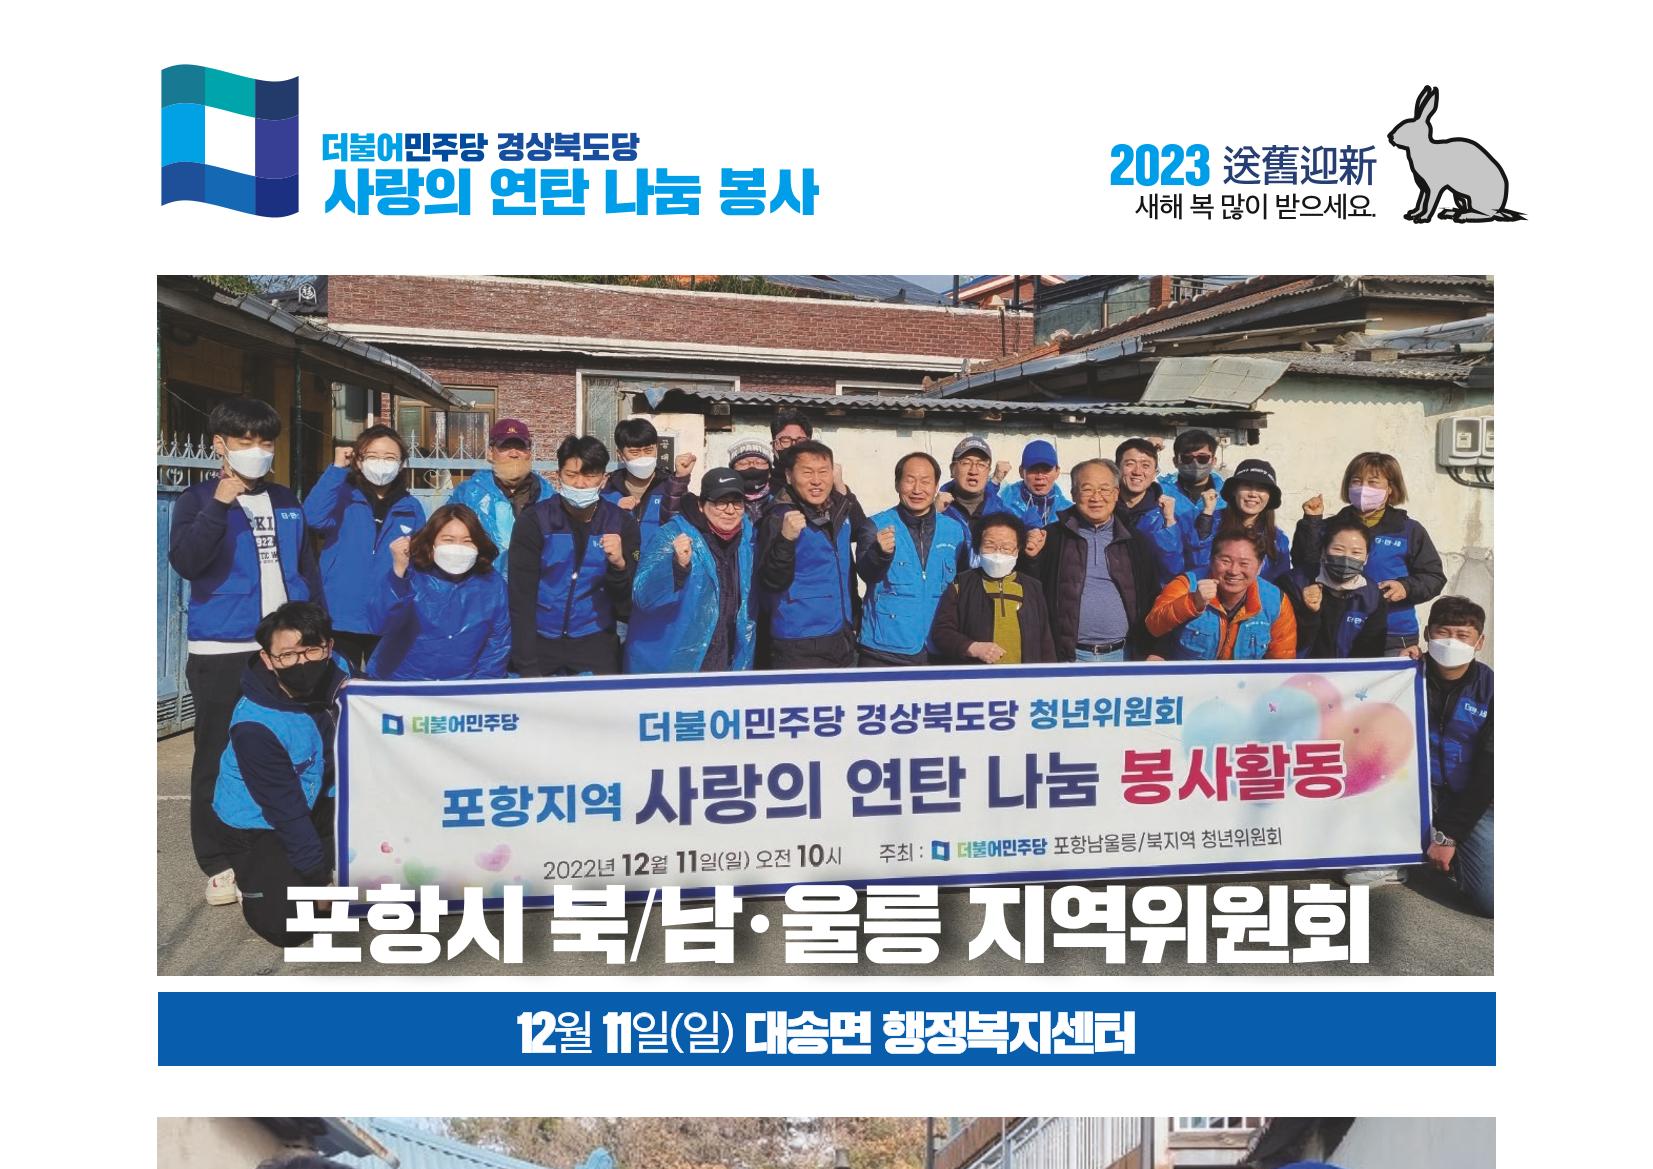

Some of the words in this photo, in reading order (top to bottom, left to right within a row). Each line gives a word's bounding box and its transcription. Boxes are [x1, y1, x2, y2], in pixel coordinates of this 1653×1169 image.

[411, 713, 519, 735] 더불어민주당
[638, 704, 845, 742] 더불어민주당
[856, 699, 1019, 736] 경상북도당
[1029, 695, 1185, 730] 청년위원회
[441, 782, 622, 829] 포항지역
[635, 760, 823, 827] 사랑의
[846, 752, 967, 818] 연탄
[987, 751, 1100, 810] 나눔
[1120, 741, 1346, 806] 봉사활동
[543, 858, 616, 880] 2022년
[621, 851, 669, 877] 12월
[675, 849, 750, 876] 11일(일)
[755, 849, 792, 869] 오전
[796, 844, 843, 868] 10시
[879, 842, 914, 864] 주최
[957, 838, 1048, 859] 더불어민주당
[1053, 830, 1196, 856] 포항남울릉/북지역
[1200, 826, 1283, 849] 청년위원회
